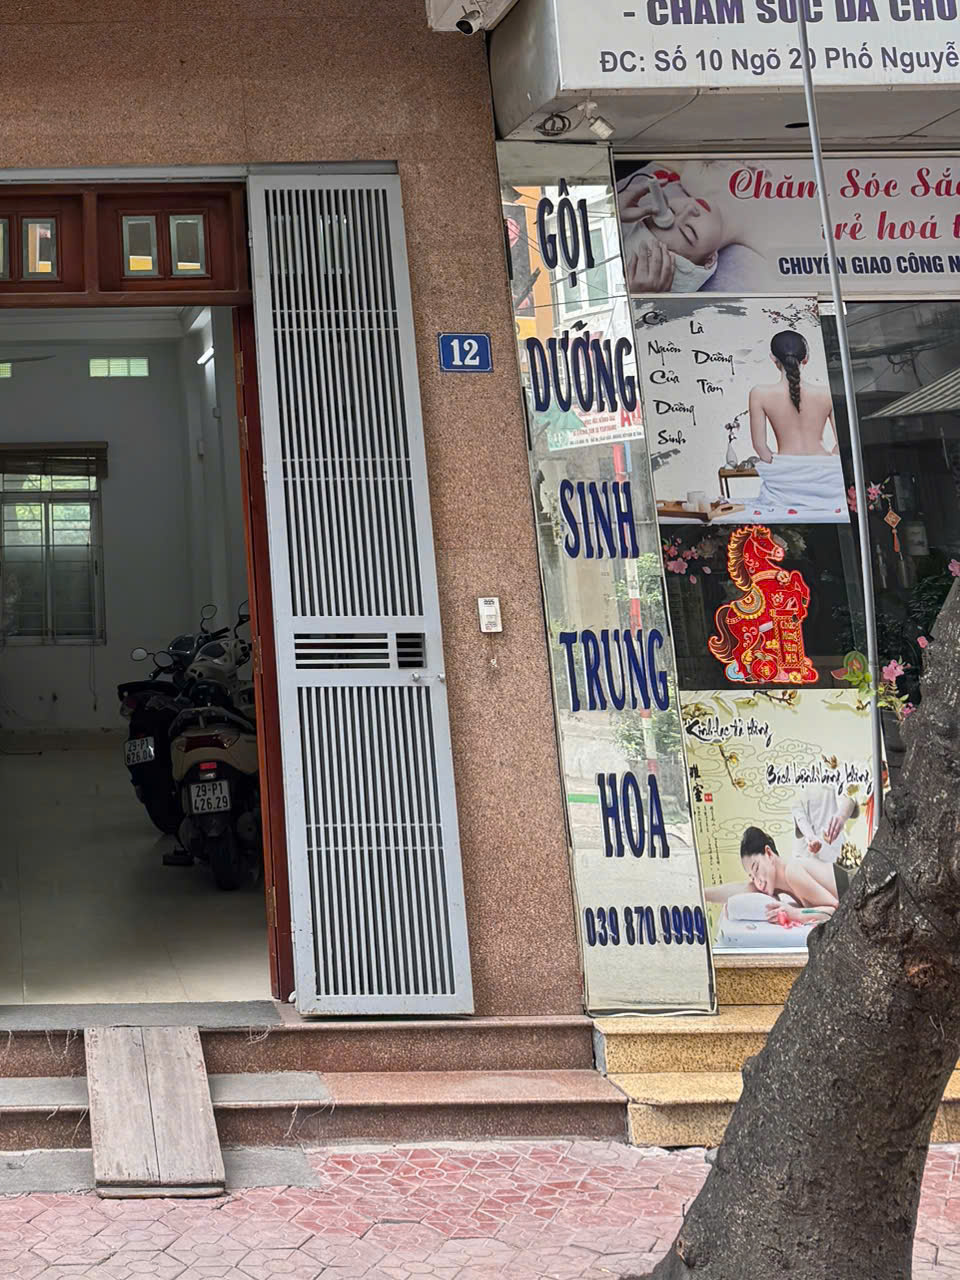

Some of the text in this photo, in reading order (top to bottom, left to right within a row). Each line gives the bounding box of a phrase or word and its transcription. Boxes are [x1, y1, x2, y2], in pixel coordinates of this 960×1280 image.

[600, 51, 645, 72] ĐC:
[654, 45, 686, 71] Số
[696, 49, 722, 71] 10
[732, 48, 781, 75] Ngõ
[825, 42, 873, 69] Phố
[881, 41, 959, 73] Nguyễ
[840, 168, 900, 198] Sóc
[910, 167, 960, 198] Sắ
[537, 178, 595, 288] GỘI
[877, 210, 943, 240] hoá
[851, 256, 892, 274] GIAO
[896, 252, 944, 273] CÔNG
[689, 320, 704, 334] Là
[450, 338, 480, 366] 12
[526, 320, 637, 413] DƯỠNG
[696, 379, 724, 396] Tâm
[657, 429, 686, 445] Sinh
[559, 478, 640, 559] SINH
[559, 628, 670, 711] TRUNG
[194, 795, 229, 812] 426.29
[195, 782, 224, 798] 29-P1
[597, 771, 671, 859] HOA
[584, 905, 706, 947] 039 870 9999
